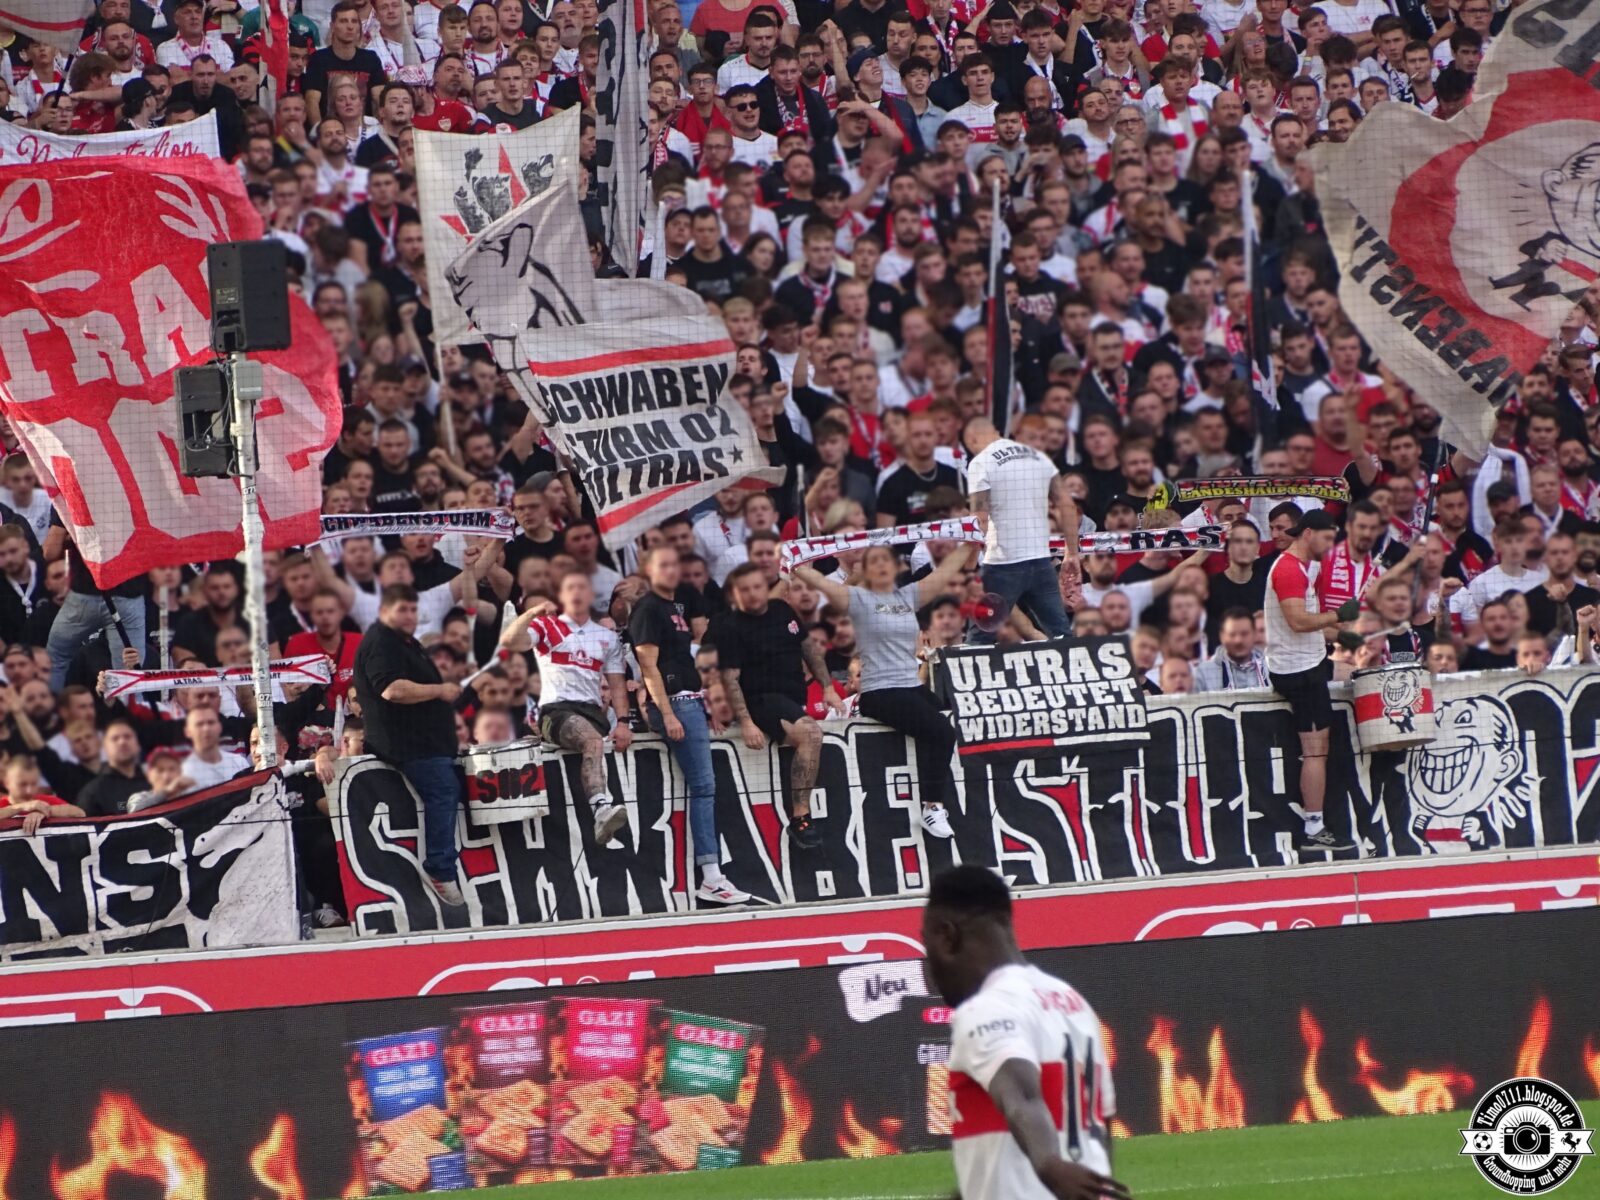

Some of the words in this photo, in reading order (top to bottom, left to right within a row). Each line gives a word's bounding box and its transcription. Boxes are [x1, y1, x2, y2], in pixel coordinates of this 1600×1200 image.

[321, 512, 490, 532] CHWABENSTURM
[946, 643, 1132, 692] ULTRAS
[954, 678, 1138, 718] BEDEUTET
[958, 704, 1147, 742] WIDERSTAND
[864, 975, 908, 1001] Neu
[479, 1013, 538, 1032] GAZI
[578, 1010, 635, 1027] GAZI
[678, 1024, 737, 1047] GAZI
[371, 1041, 431, 1065] GAZI
